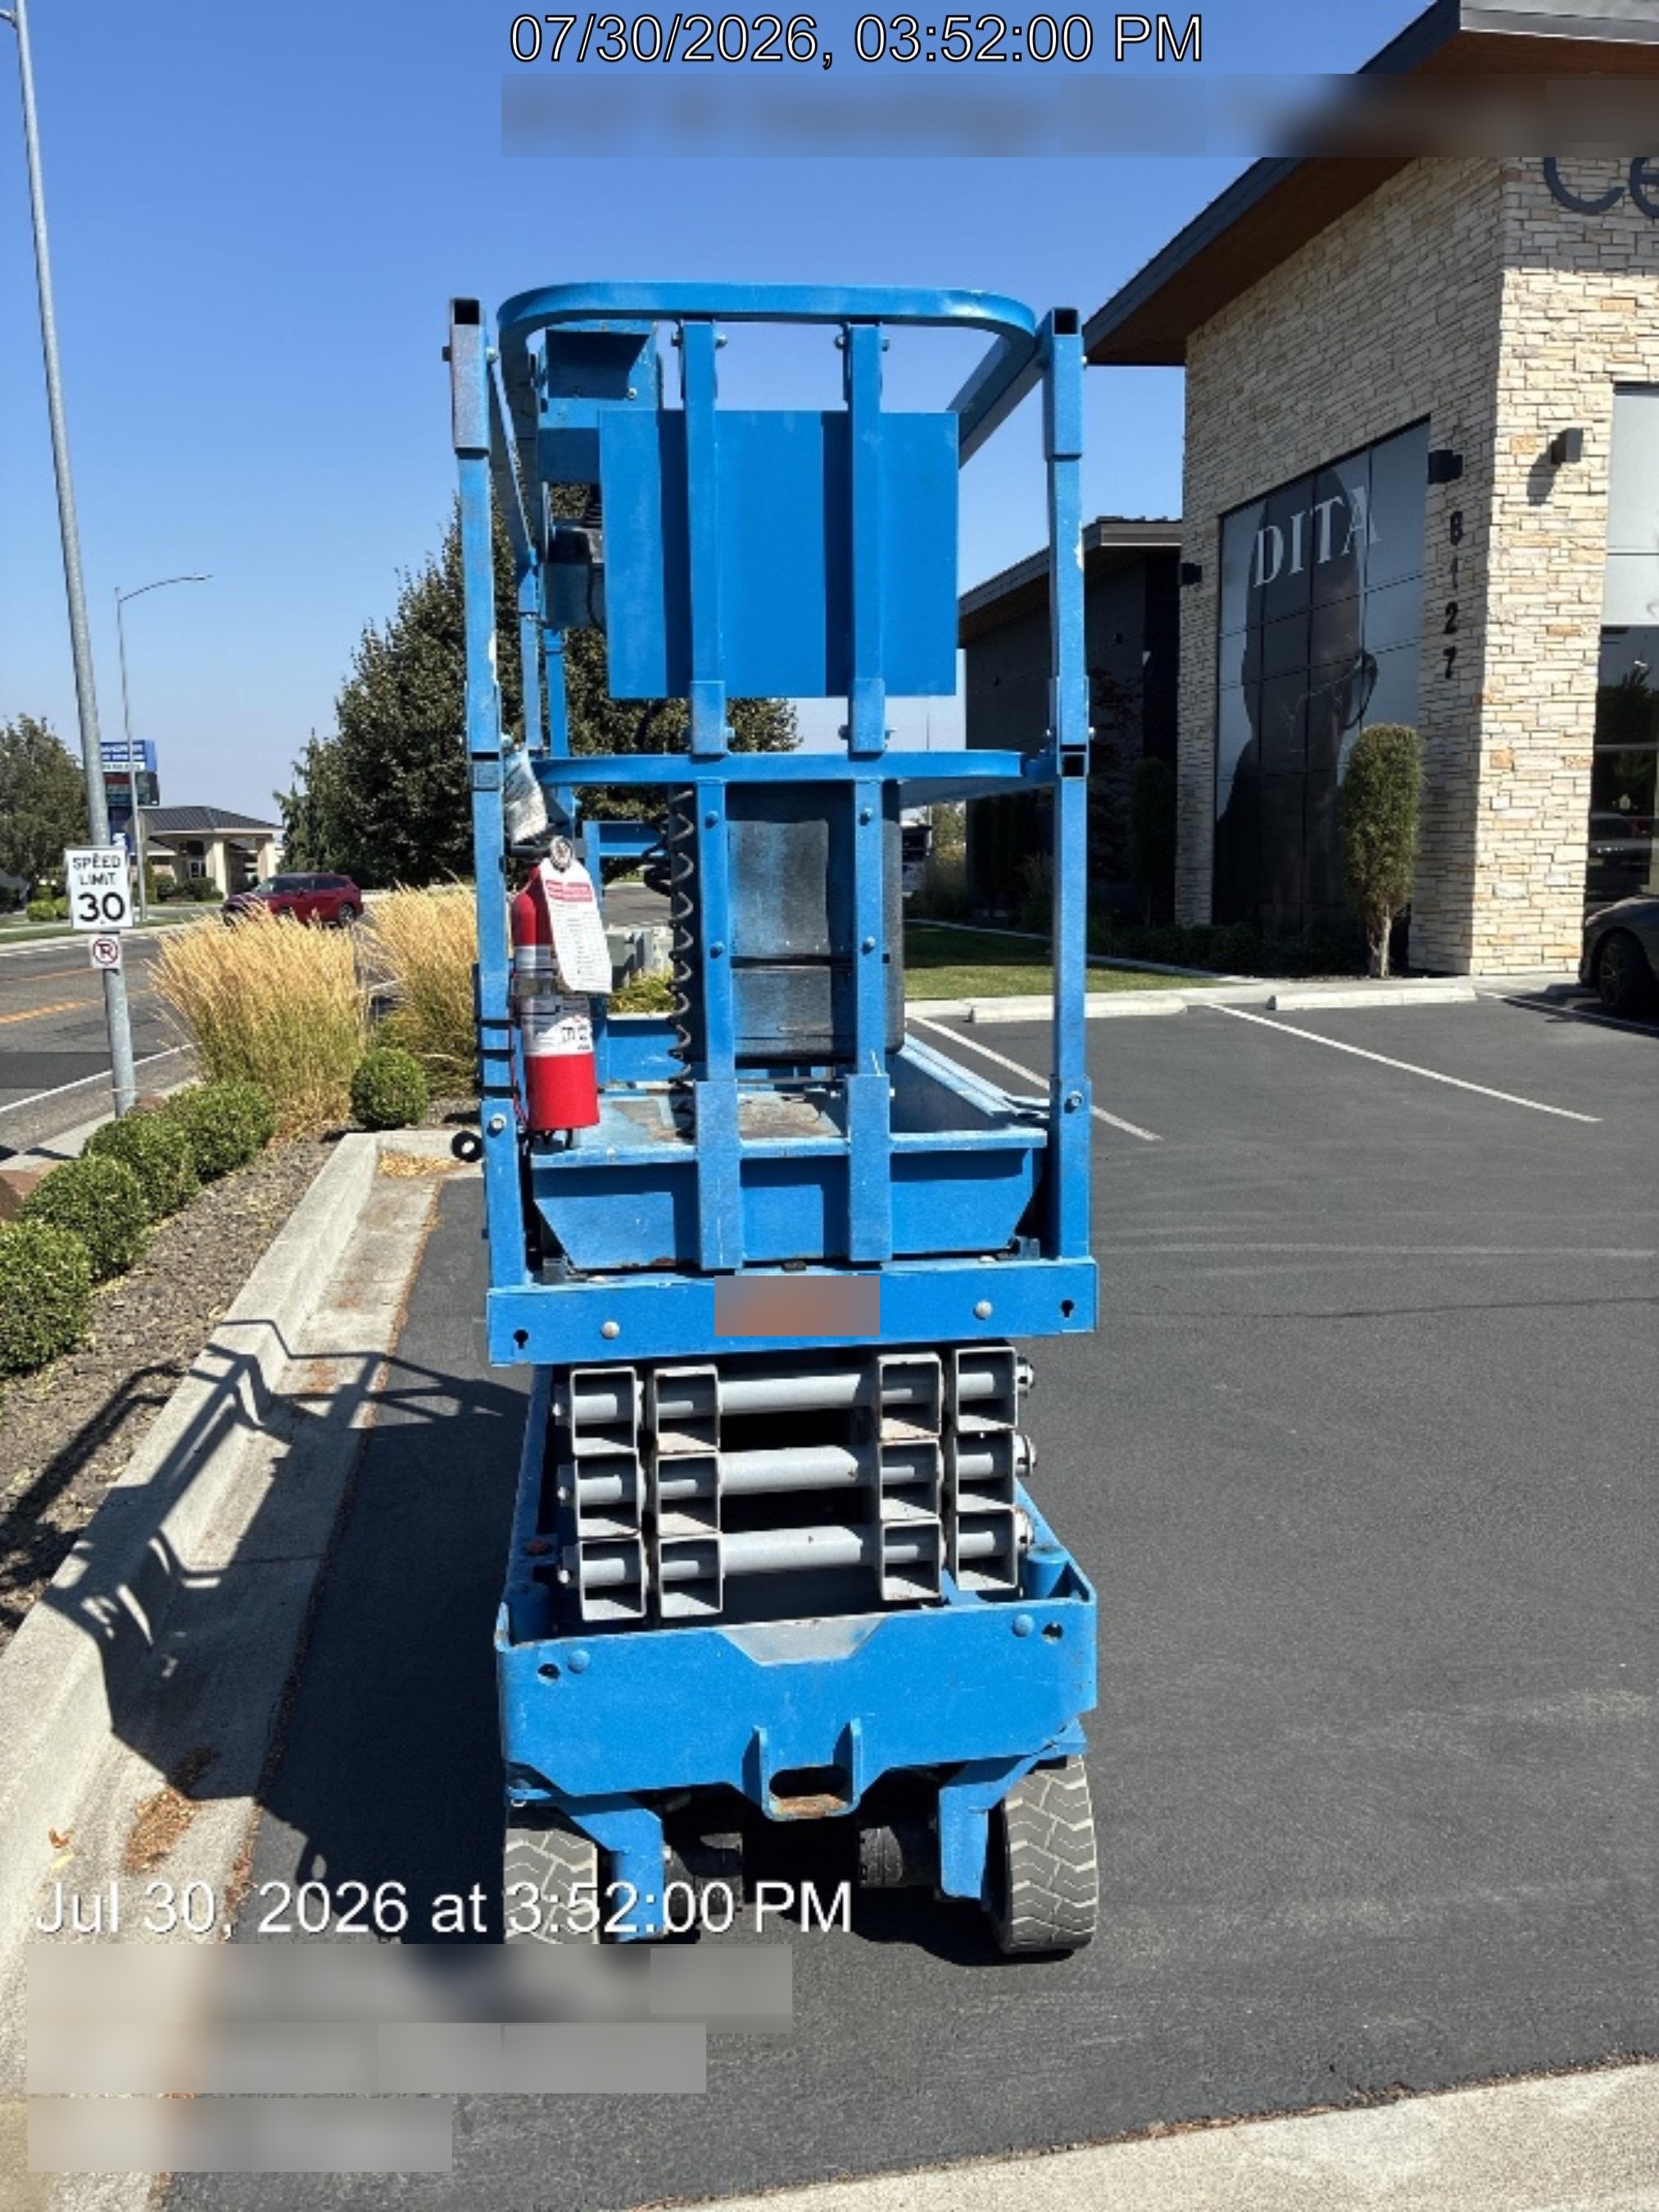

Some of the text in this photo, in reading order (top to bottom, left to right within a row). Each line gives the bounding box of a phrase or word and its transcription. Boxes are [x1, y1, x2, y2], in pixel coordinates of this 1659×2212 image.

[1253, 486, 1383, 588] DITA
[1443, 510, 1464, 679] 8127
[72, 853, 121, 870] SPEED
[79, 872, 116, 886] LIMIT
[78, 891, 125, 922] 30
